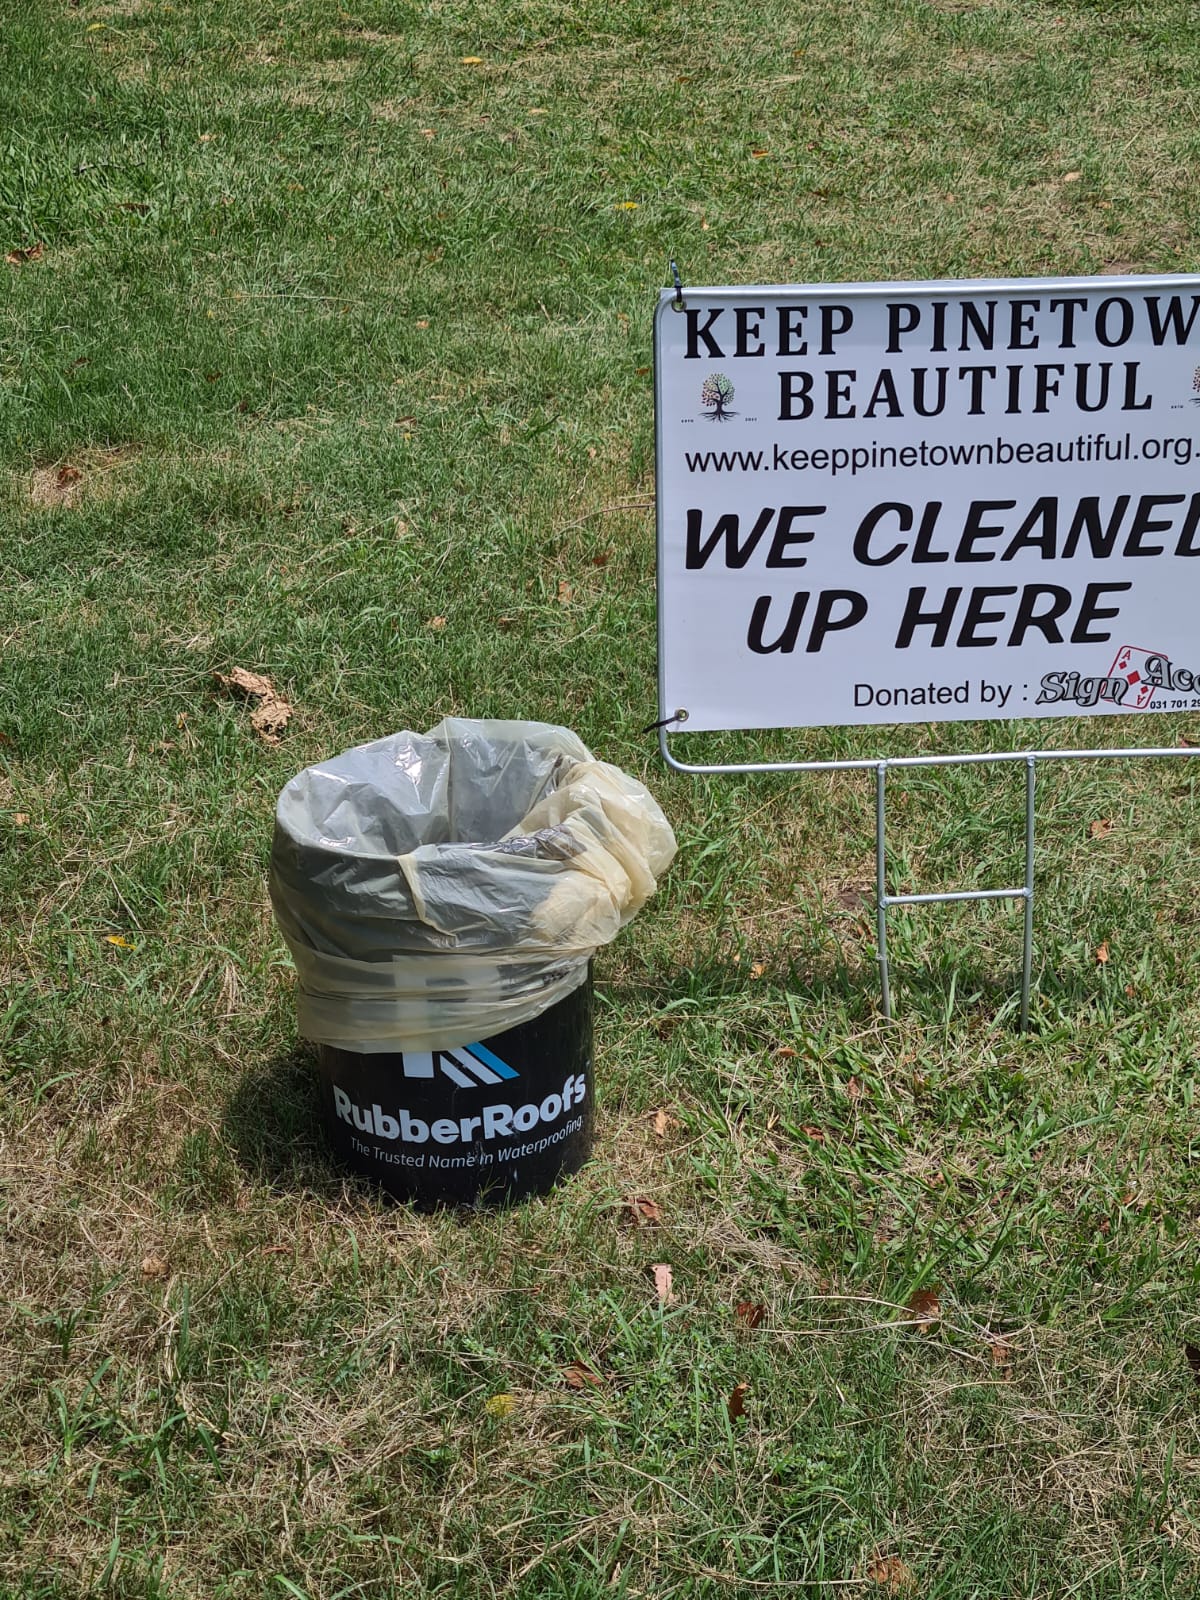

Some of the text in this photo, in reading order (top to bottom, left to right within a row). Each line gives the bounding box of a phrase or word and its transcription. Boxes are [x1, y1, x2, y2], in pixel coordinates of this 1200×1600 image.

[683, 295, 1200, 359] KEEP PINETOW
[777, 361, 1153, 421] BEAUTIFUL
[685, 505, 826, 570] WE
[747, 581, 1132, 654] UP HERE
[854, 680, 969, 707] Donated
[981, 680, 1012, 708] by
[1035, 671, 1129, 707] Sign
[1150, 700, 1167, 710] 031
[1170, 699, 1187, 709] 701
[333, 1073, 586, 1144] RubberRoofs
[351, 1137, 370, 1157] The
[373, 1147, 425, 1168] Trusted
[428, 1155, 475, 1169] Name
